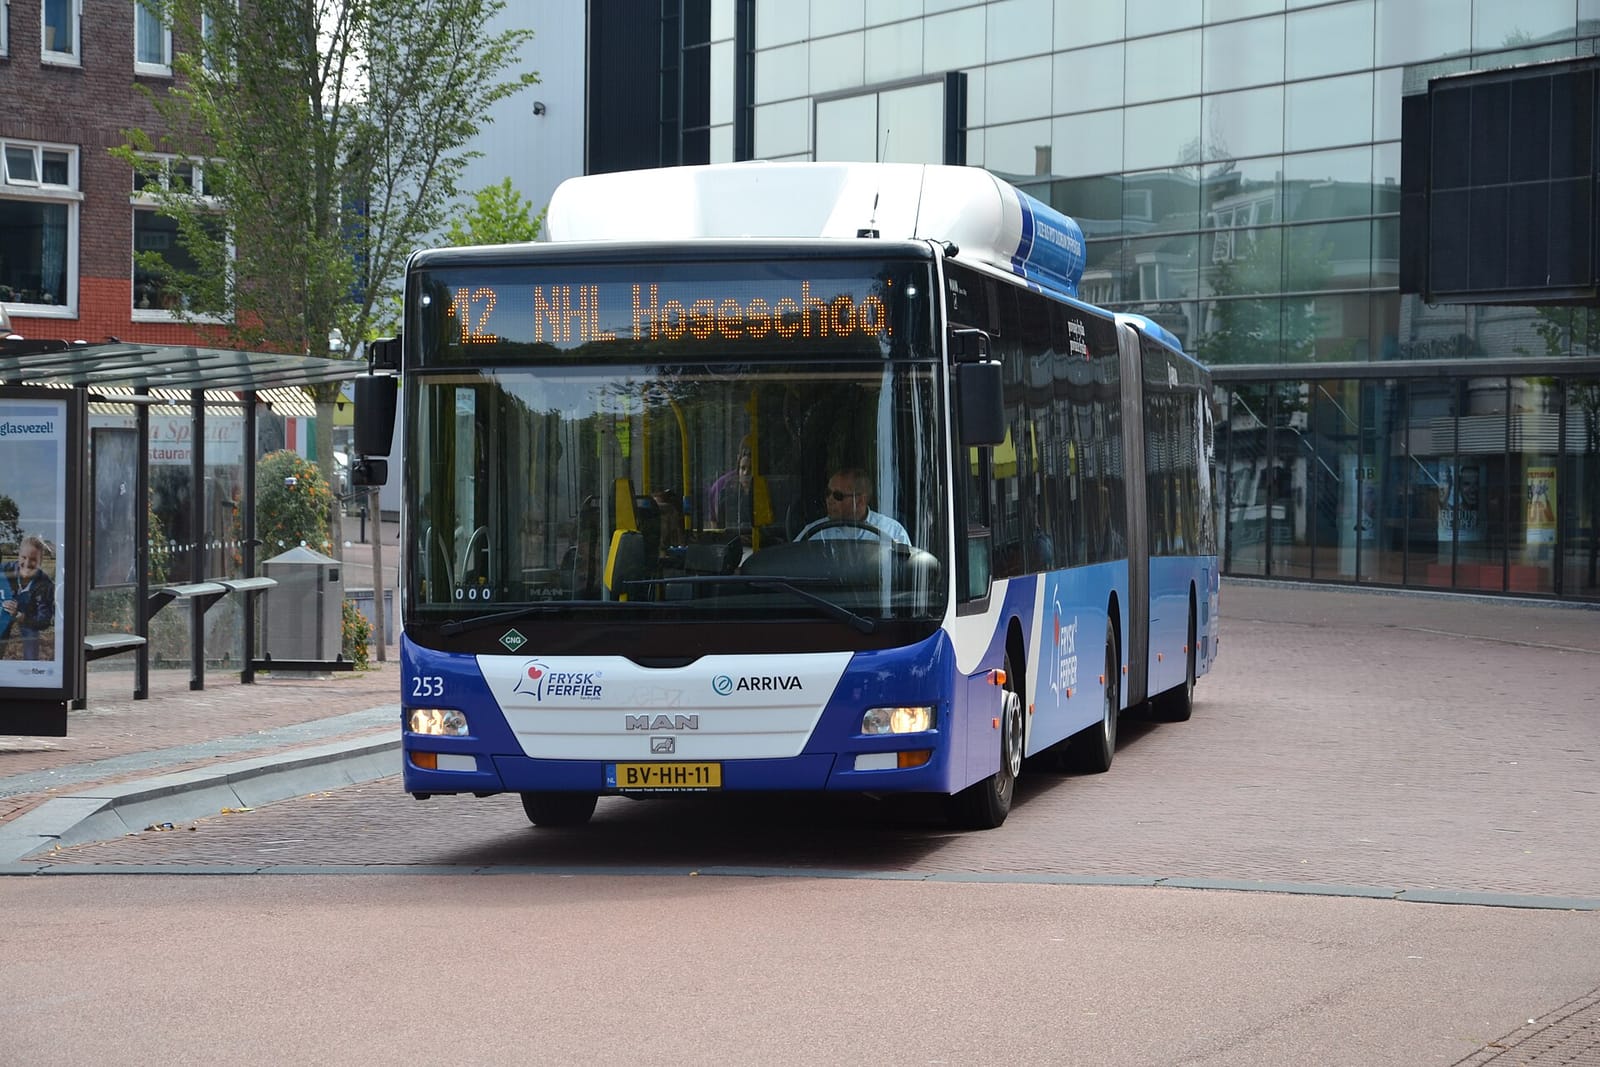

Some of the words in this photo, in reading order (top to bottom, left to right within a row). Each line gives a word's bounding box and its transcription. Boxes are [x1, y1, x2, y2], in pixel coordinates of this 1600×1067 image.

[447, 287, 497, 343] 12
[534, 285, 616, 342] NHL
[633, 280, 891, 341] Hogeschoo
[0, 421, 53, 436] glasvezel!
[505, 636, 521, 644] CNG
[412, 676, 444, 696] 253
[548, 673, 594, 684] FRYSK
[736, 676, 803, 691] ARRIVA
[546, 685, 602, 696] FERFIER
[625, 714, 699, 730] MAN
[627, 766, 709, 784] BV-HH-11
